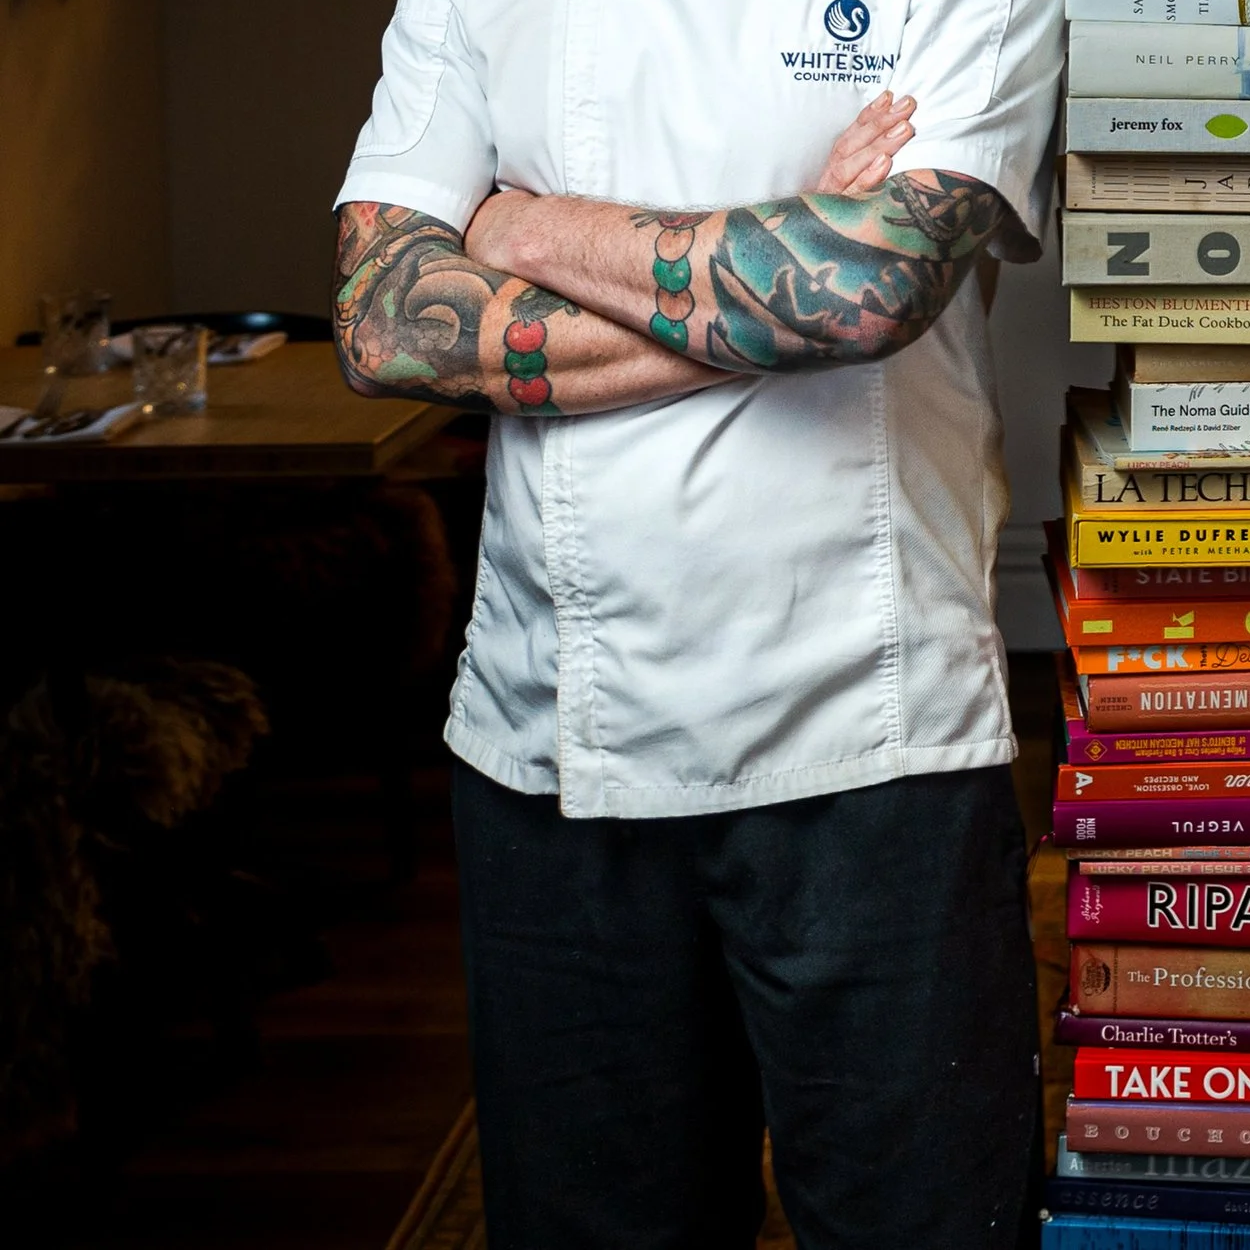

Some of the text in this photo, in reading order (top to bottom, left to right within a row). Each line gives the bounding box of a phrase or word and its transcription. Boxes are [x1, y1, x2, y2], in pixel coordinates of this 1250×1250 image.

[834, 43, 859, 53] THE
[781, 52, 847, 70] WHITE
[1136, 55, 1174, 65] NEIL
[1186, 56, 1240, 66] PERRY
[794, 72, 852, 83] COUNTRY
[1110, 118, 1158, 133] jeremy
[1161, 118, 1183, 131] fox
[1089, 297, 1157, 309] HESTON
[1100, 315, 1128, 327] The
[1132, 316, 1154, 327] Fat
[1158, 316, 1194, 328] Duck
[1152, 405, 1176, 417] The
[1180, 405, 1216, 416] Noma
[1152, 424, 1168, 432] René
[1170, 424, 1196, 433] Redzepi
[1159, 461, 1190, 469] PEACH
[1095, 473, 1147, 503] LA
[1098, 530, 1164, 543] WYLIE
[1162, 547, 1199, 555] PETER
[1096, 704, 1132, 712] CHELSEA
[1115, 739, 1149, 750] KITCHEN
[1150, 738, 1184, 749] MEXICAN
[1076, 818, 1086, 841] FOOD
[1086, 817, 1096, 840] NUDE
[1171, 820, 1244, 833] VEGFUL
[1078, 850, 1123, 858] LUCKY
[1126, 849, 1172, 857] PEACH
[1090, 865, 1135, 874] LUCKY
[1141, 865, 1192, 874] PEACH
[1201, 865, 1242, 874] ISSUE
[1128, 971, 1150, 983] The
[1101, 1025, 1237, 1046] Charlie Trotter's
[1105, 1065, 1192, 1098] TAKE
